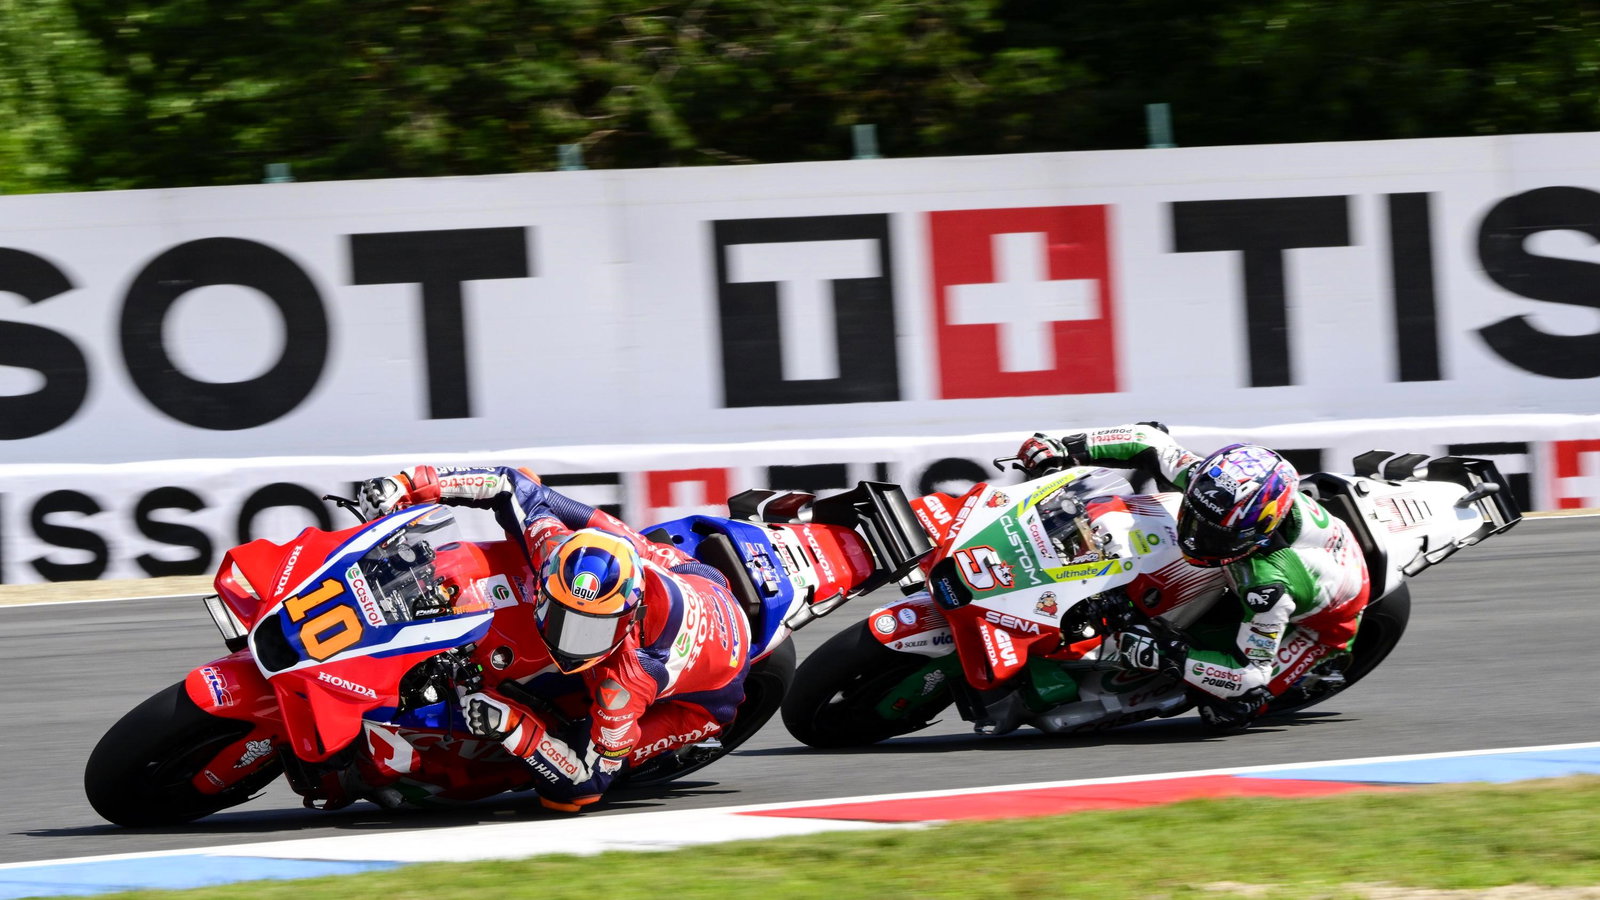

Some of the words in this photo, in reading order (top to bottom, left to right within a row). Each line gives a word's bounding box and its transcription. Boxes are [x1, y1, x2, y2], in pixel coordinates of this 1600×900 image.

[438, 475, 485, 489] Castro
[945, 495, 978, 540] SENA
[1193, 487, 1225, 516] SHARK
[0, 480, 364, 583] SSO
[916, 508, 941, 541] HONDA
[802, 524, 836, 584] HONDA
[1000, 514, 1043, 586] CUSTOM
[273, 544, 304, 598] HONDA
[952, 544, 1016, 592] 5
[1055, 567, 1099, 580] ultimate
[352, 578, 384, 628] Castrol
[573, 587, 596, 601] agv
[941, 577, 960, 607] DAYCO
[281, 577, 364, 664] 10
[985, 611, 1040, 634] SENA
[904, 639, 928, 649] SOLIZE
[980, 624, 999, 667] HONDA
[318, 671, 378, 699] HONDA
[1205, 666, 1243, 682] Castrol
[540, 740, 578, 775] Castrol
[597, 736, 634, 748] HONDA
[634, 721, 721, 761] HONDA
